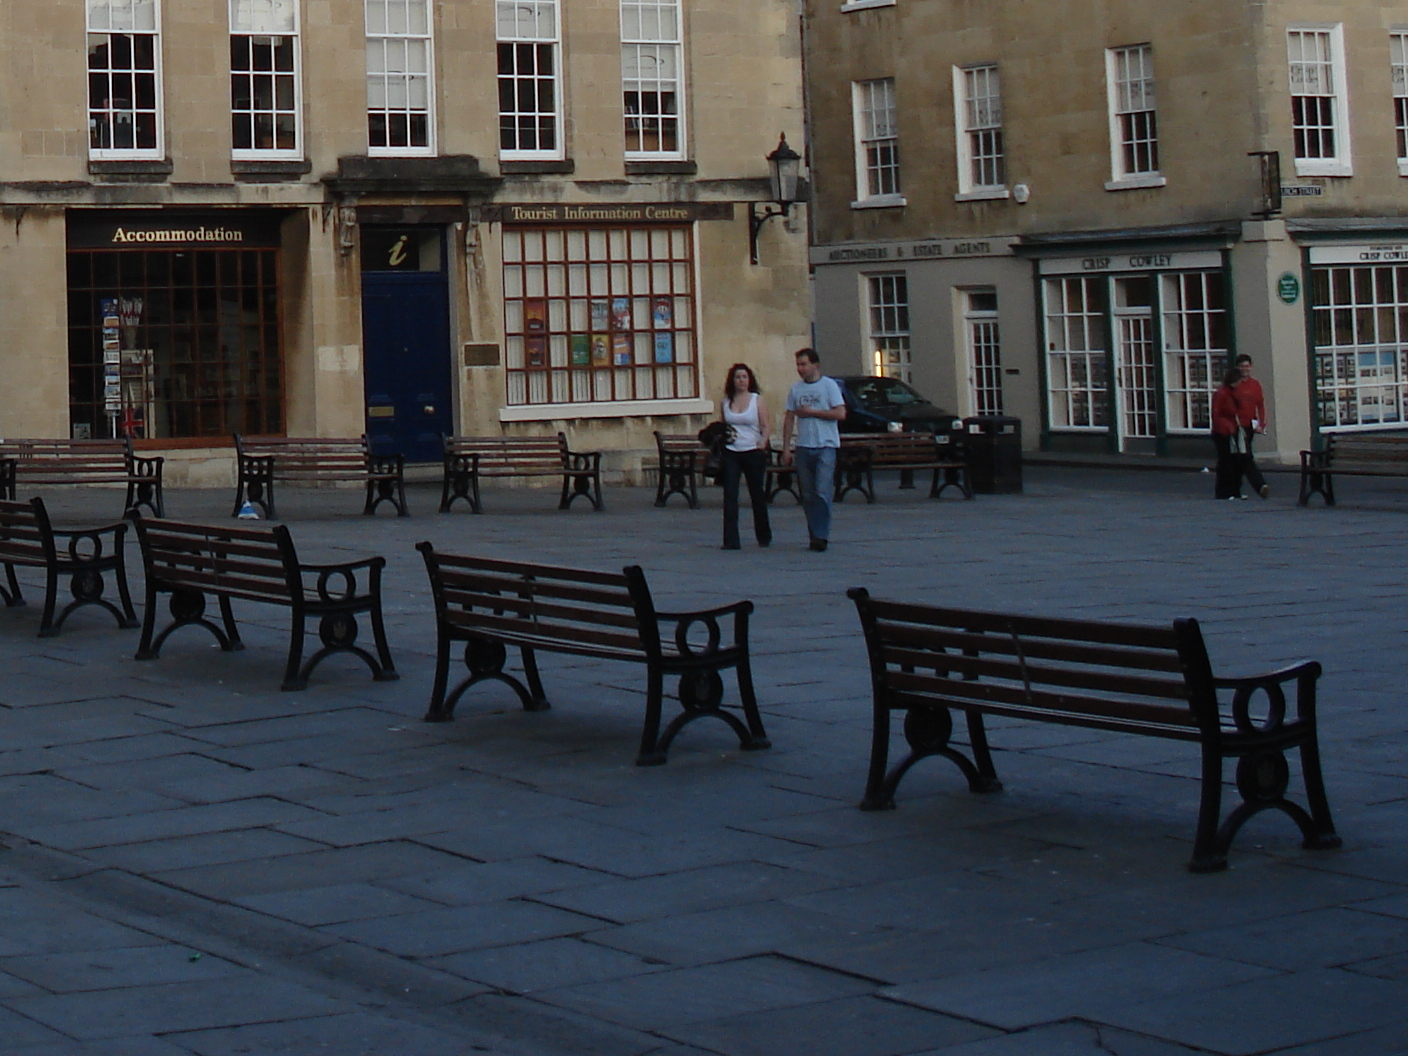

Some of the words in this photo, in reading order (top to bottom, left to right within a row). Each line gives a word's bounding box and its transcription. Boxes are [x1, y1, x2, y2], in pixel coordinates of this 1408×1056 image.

[1300, 187, 1321, 196] STREET
[512, 207, 558, 220] Tourist
[564, 206, 641, 220] Information
[645, 206, 688, 219] Centre
[112, 227, 242, 242] Accommodation
[913, 245, 942, 257] ESTATE
[954, 242, 991, 254] AGENTS
[1082, 258, 1111, 270] CRISP
[1129, 254, 1172, 268] COWLEY
